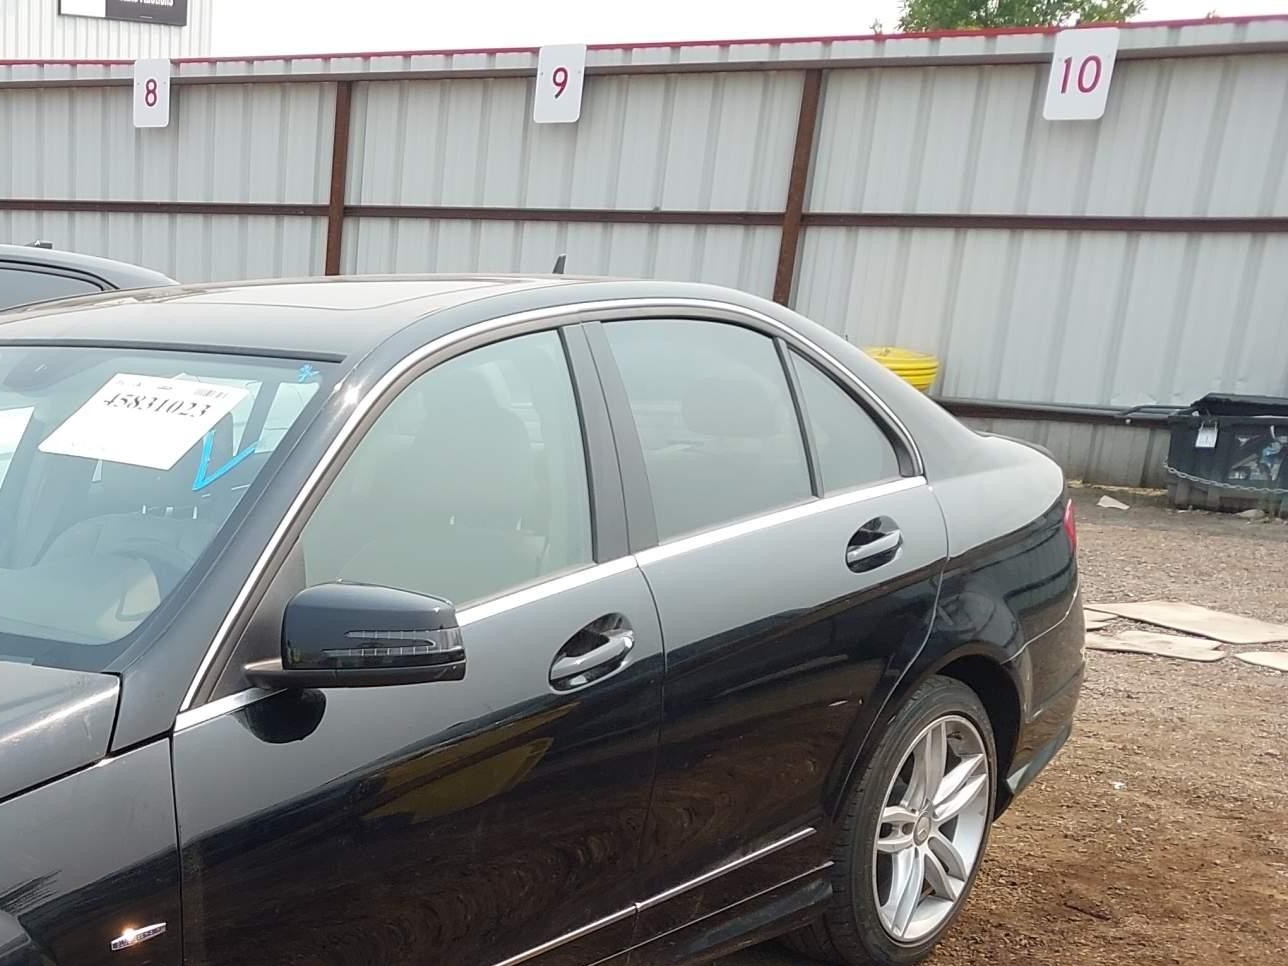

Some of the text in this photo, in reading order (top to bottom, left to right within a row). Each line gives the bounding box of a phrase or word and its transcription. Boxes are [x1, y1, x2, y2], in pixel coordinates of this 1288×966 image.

[552, 66, 569, 99] 9
[1060, 55, 1102, 95] 10
[144, 78, 158, 107] 8
[103, 392, 212, 418] 45831023
